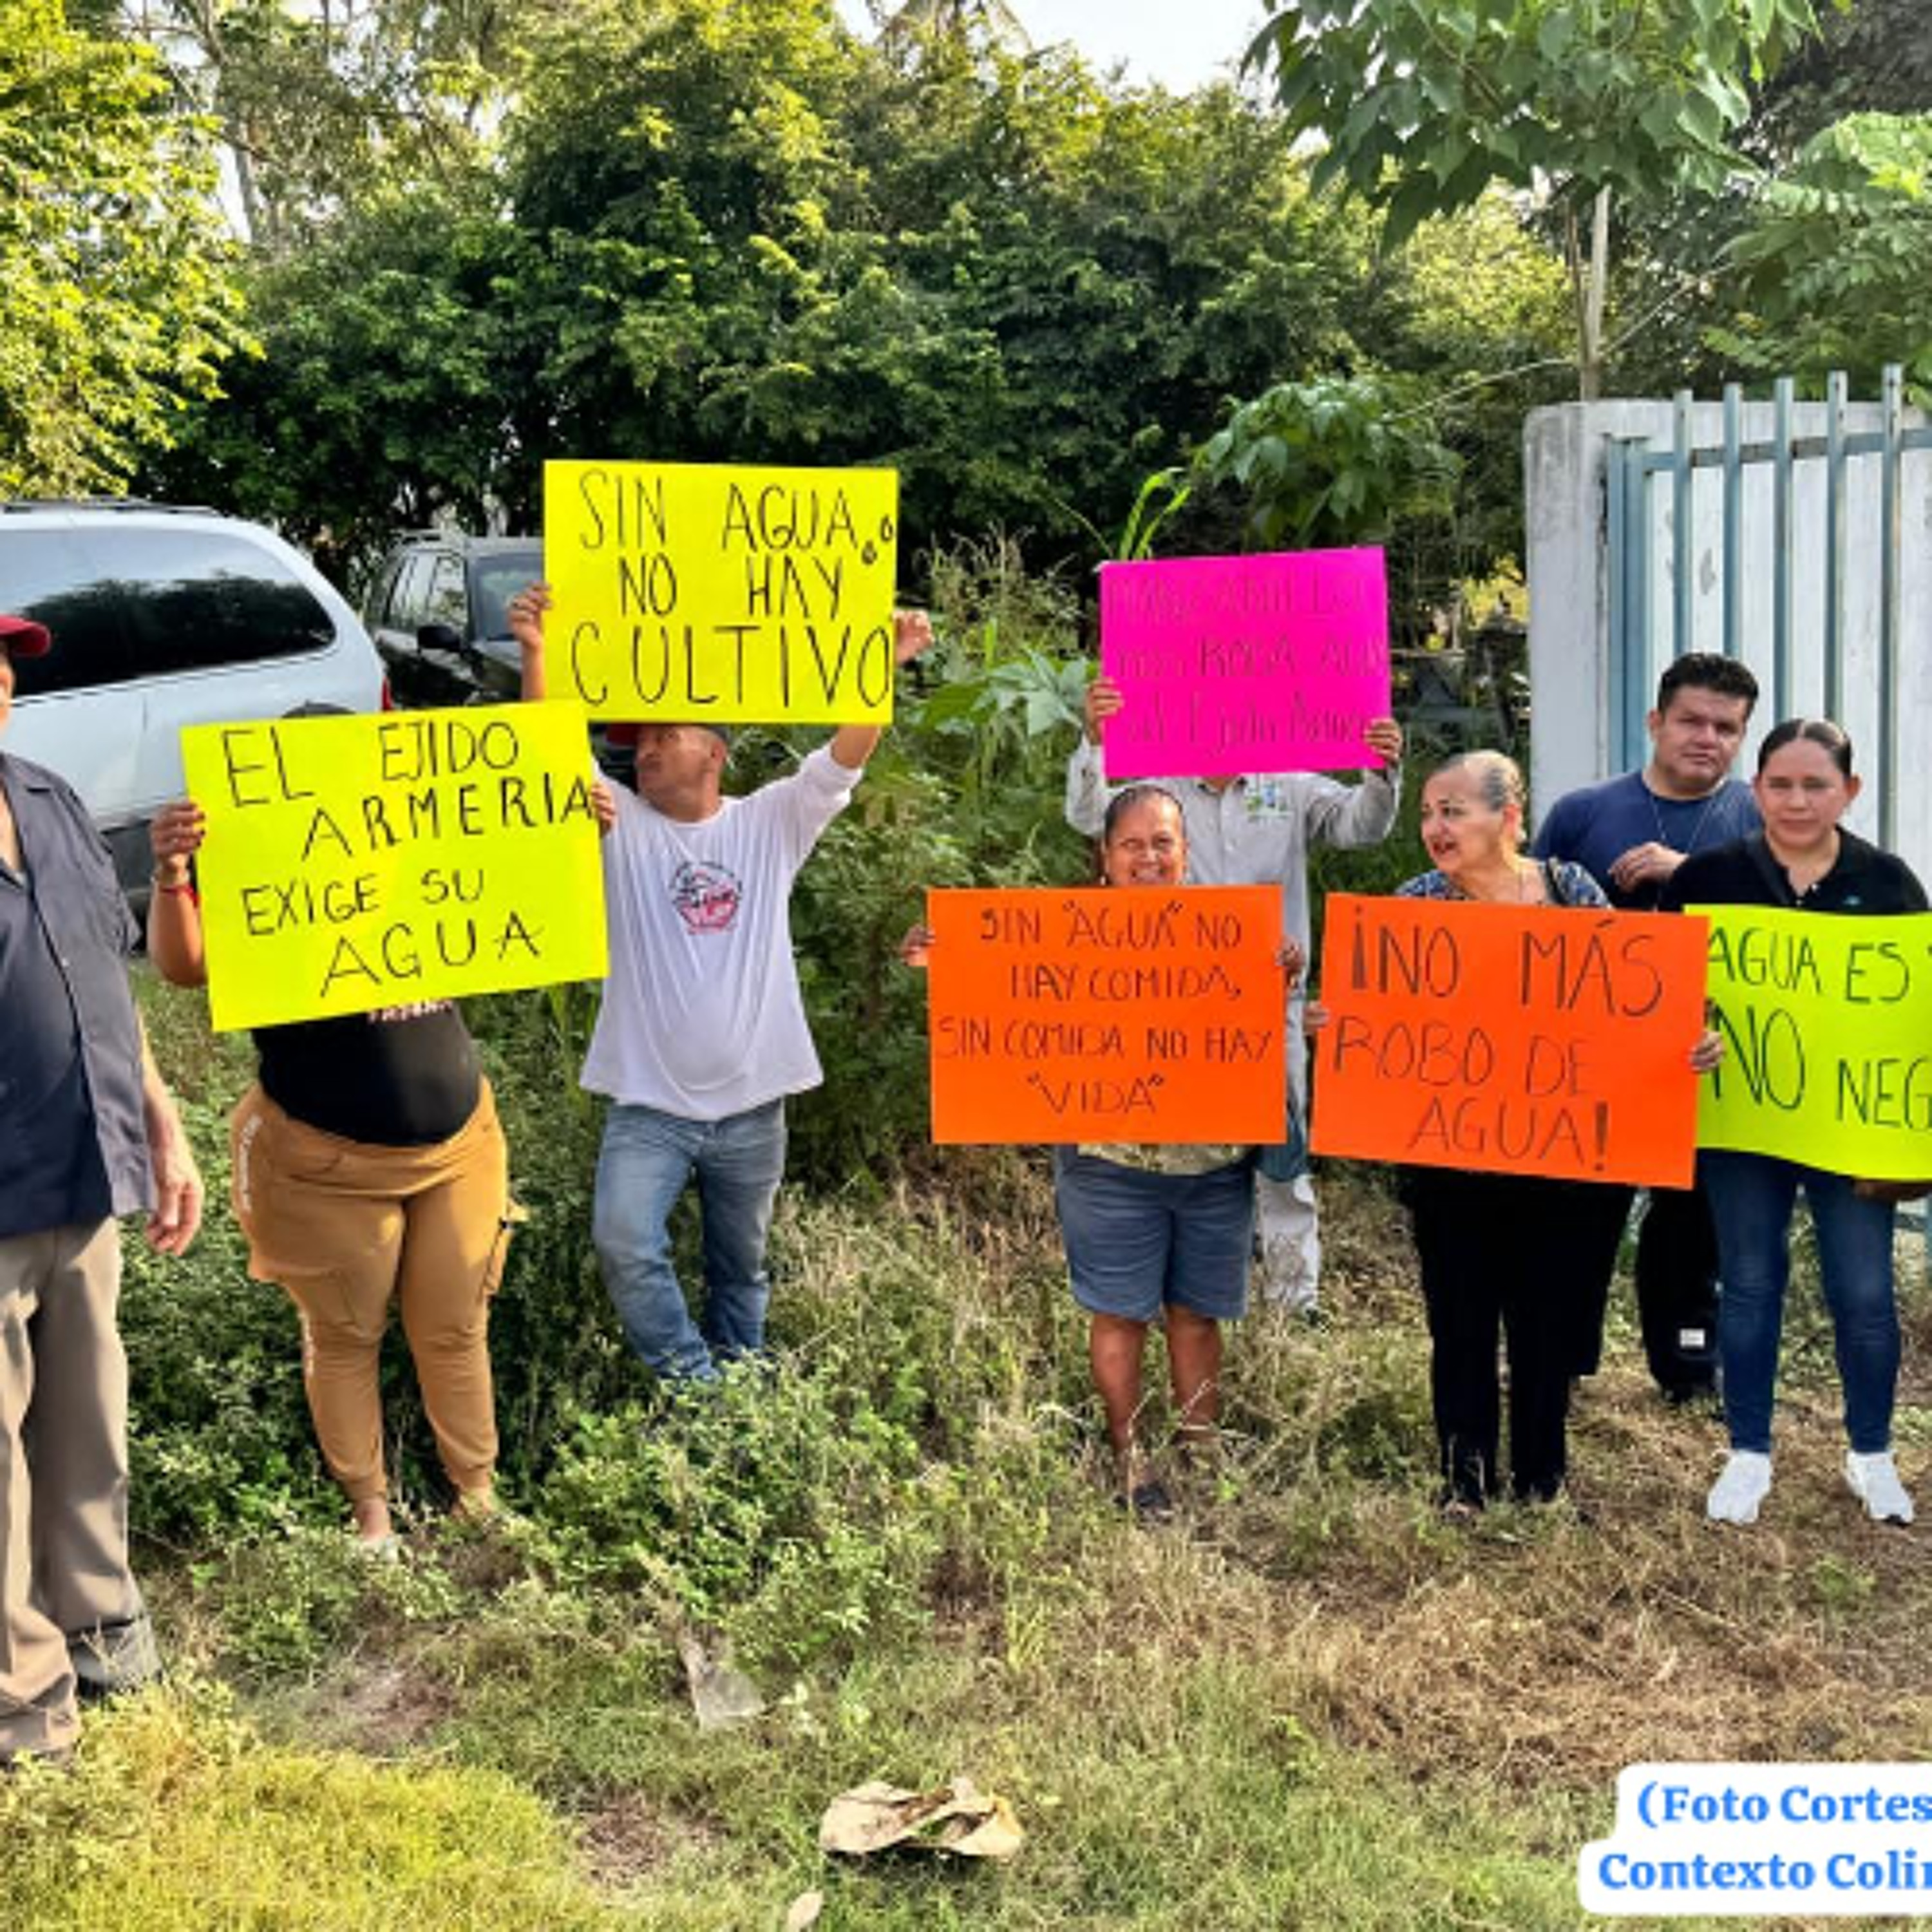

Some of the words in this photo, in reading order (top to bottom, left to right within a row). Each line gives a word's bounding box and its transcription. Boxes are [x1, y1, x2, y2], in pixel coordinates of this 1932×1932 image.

[580, 468, 667, 550] SIN
[619, 553, 677, 618] NO
[746, 553, 843, 620] HAY
[571, 622, 890, 708] CULTIVO
[222, 725, 315, 808] EL
[378, 721, 519, 781] EJIDO
[301, 772, 594, 862] ARMERIA
[241, 874, 380, 936] EXIGE
[422, 868, 484, 904] SU
[981, 908, 1041, 943] SIN
[1197, 914, 1242, 950] NO
[321, 911, 544, 998] AGUA
[1012, 964, 1079, 1001] HAY
[1522, 919, 1663, 1018] MÁS
[1707, 927, 1821, 994] AGUA
[1844, 942, 1910, 1004] ES
[938, 1016, 990, 1059] SIN
[1004, 1023, 1124, 1059] COMIDA
[1148, 1030, 1188, 1061] NO
[1206, 1028, 1272, 1063] HAY
[1334, 1015, 1494, 1087] ROBO
[1525, 1034, 1588, 1095] DE
[1408, 1096, 1609, 1171] AGUA!
